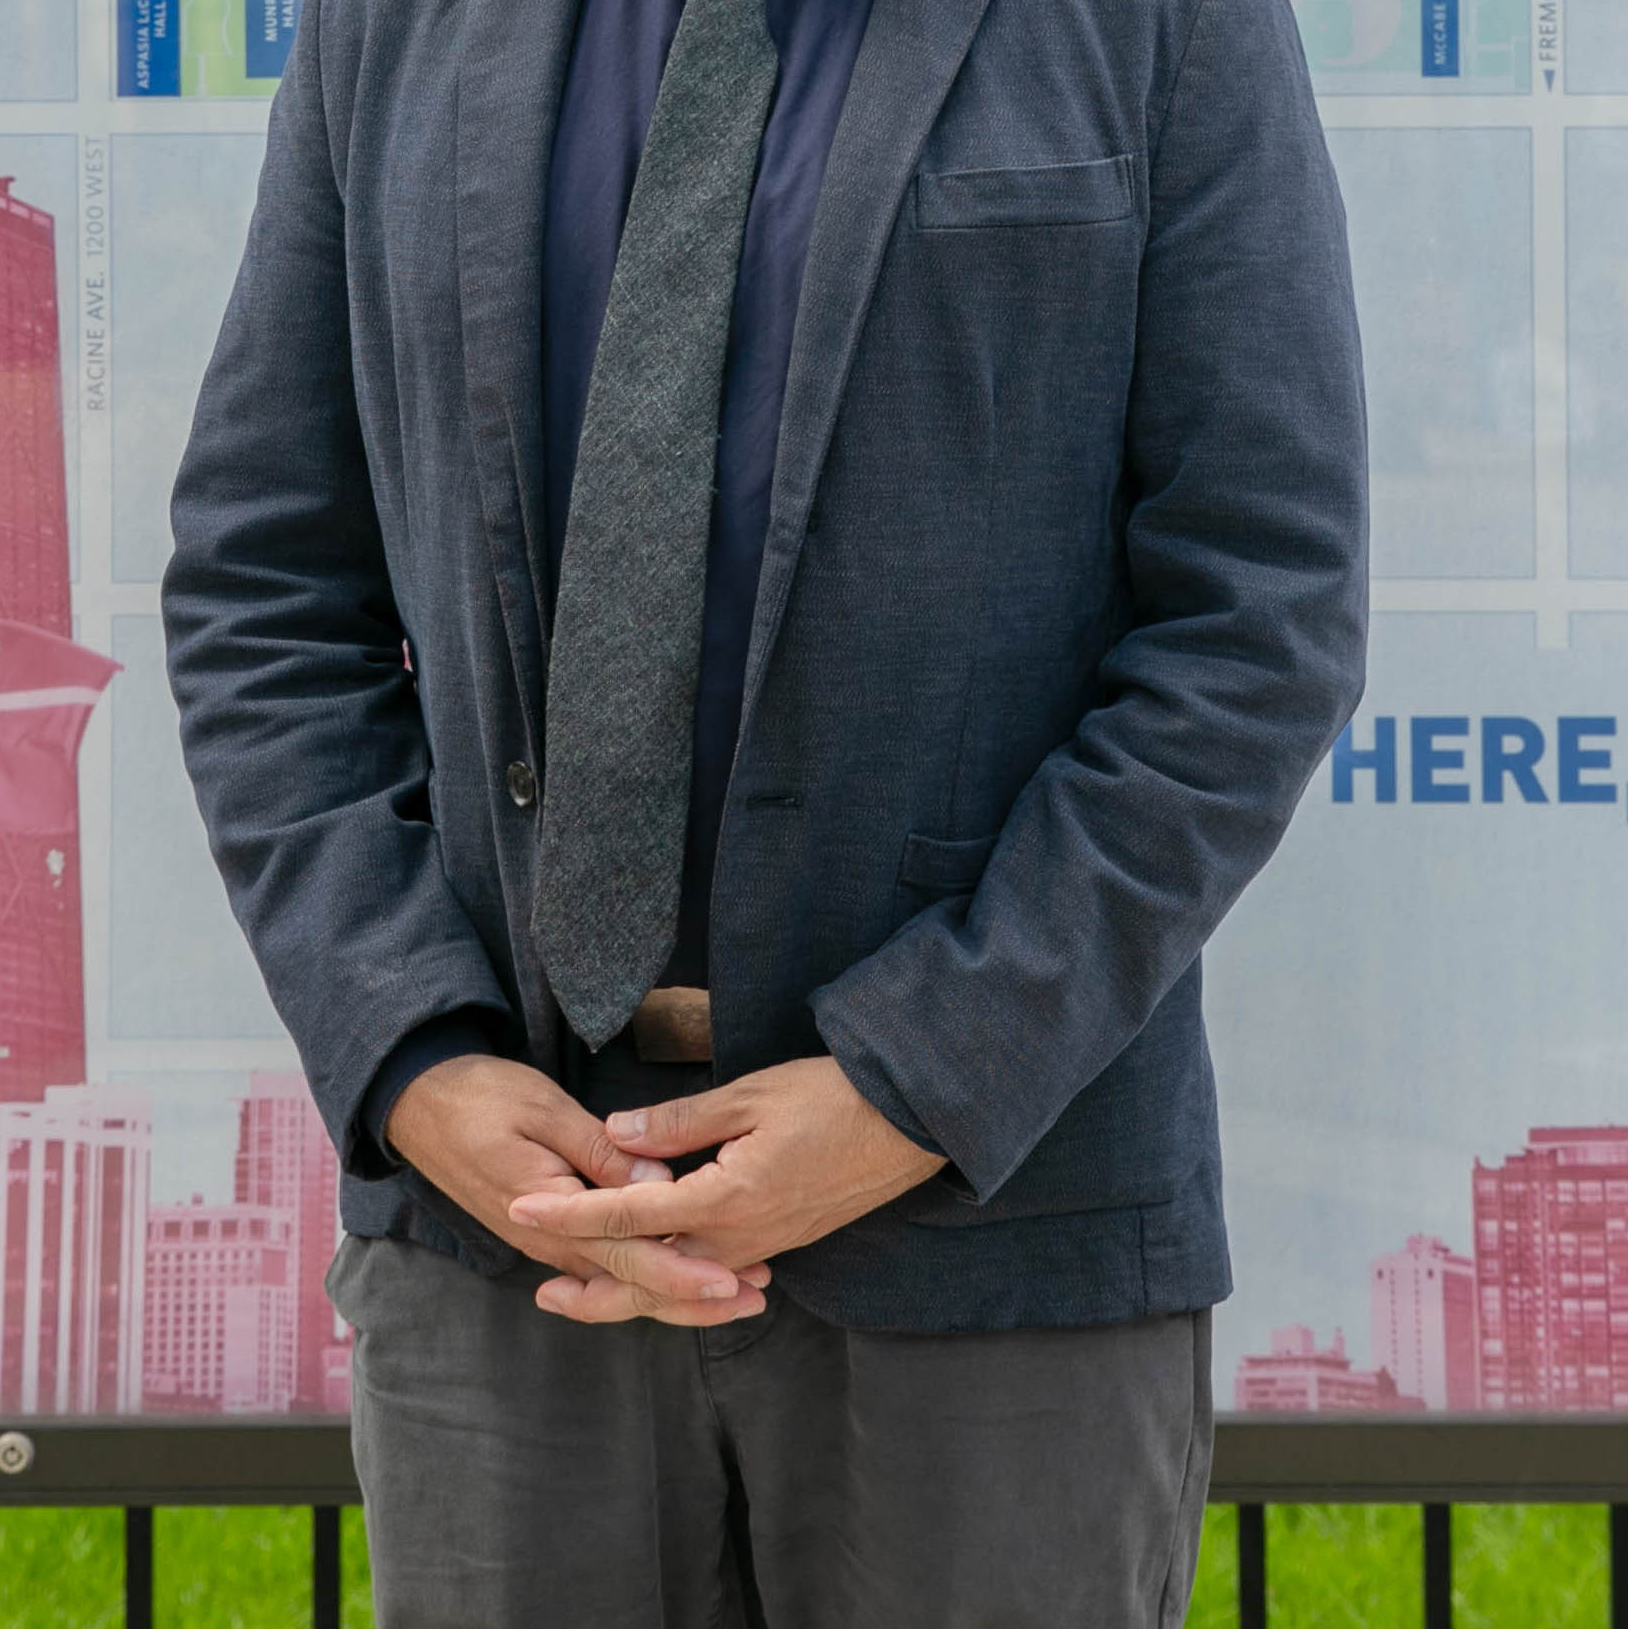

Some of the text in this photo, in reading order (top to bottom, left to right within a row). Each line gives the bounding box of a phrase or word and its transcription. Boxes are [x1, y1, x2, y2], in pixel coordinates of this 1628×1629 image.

[154, 0, 167, 38] HALL
[137, 28, 149, 90] ASPASIA
[85, 135, 106, 411] RACINE AVE. 1200 WEST
